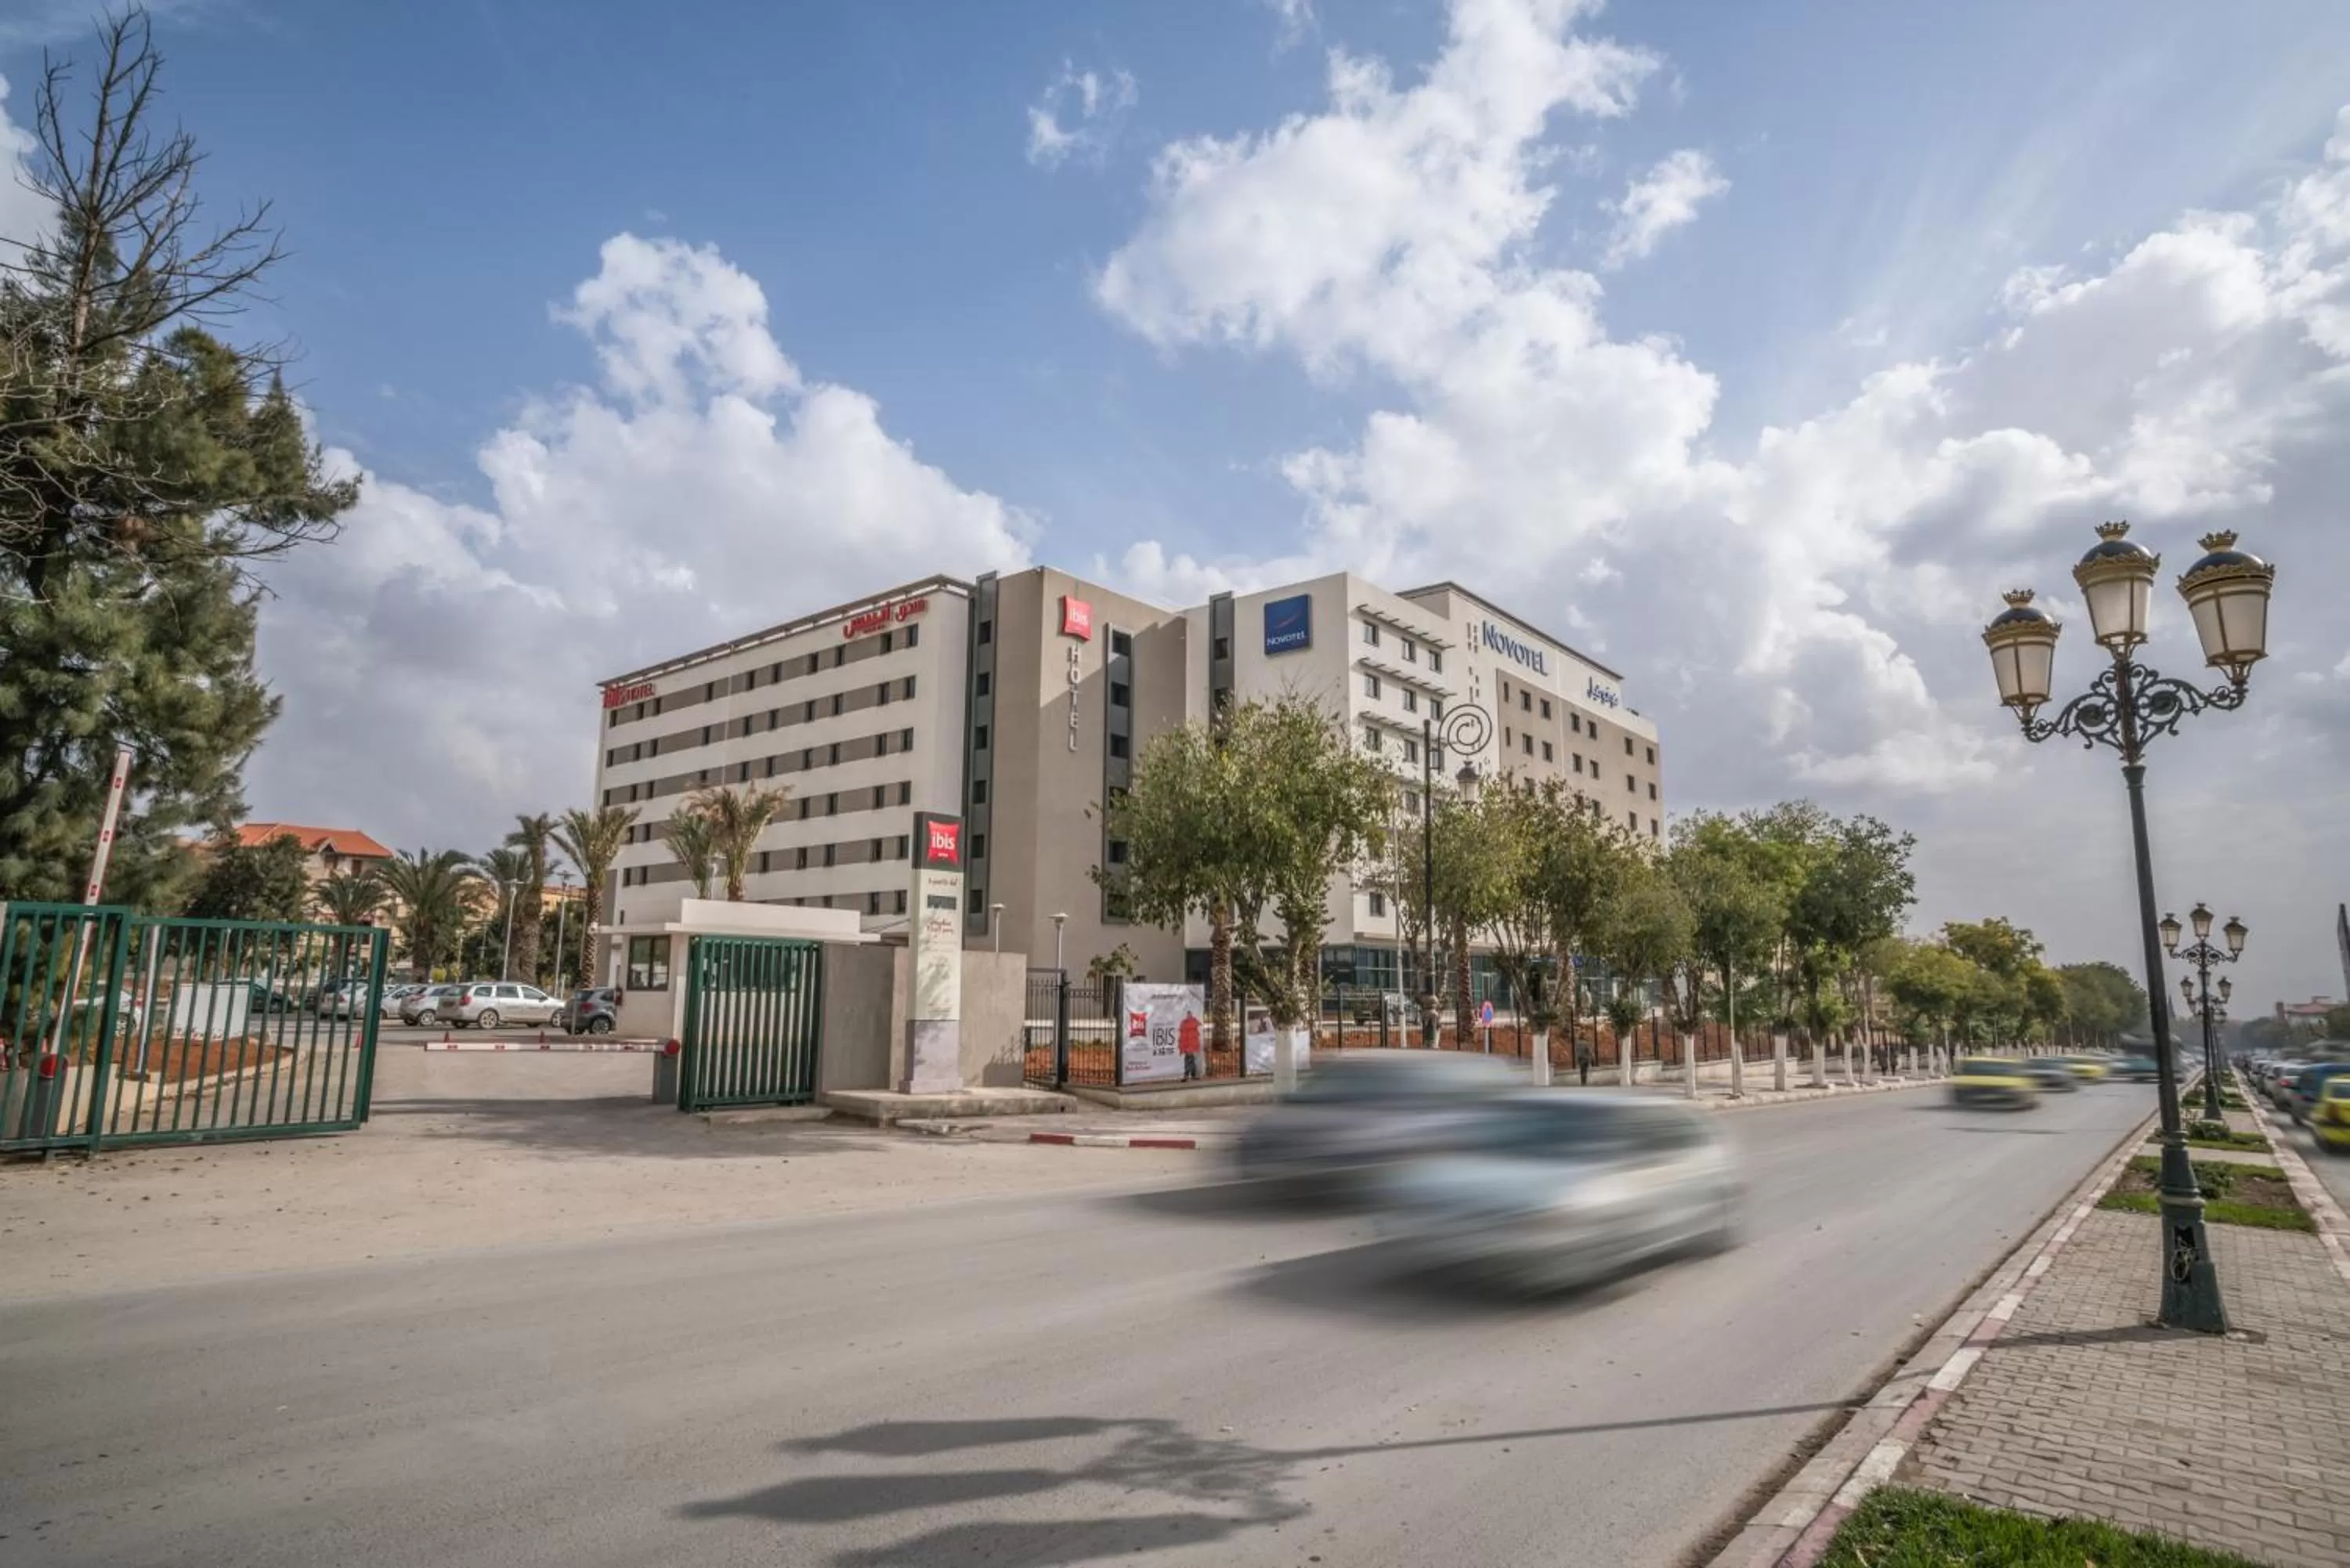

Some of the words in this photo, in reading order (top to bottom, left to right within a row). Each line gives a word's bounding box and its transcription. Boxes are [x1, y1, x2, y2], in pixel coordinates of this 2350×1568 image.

[1069, 607, 1088, 625] ibis
[1266, 630, 1307, 646] NOVOTEL
[1482, 620, 1548, 677] NOVOTEL
[1069, 645, 1080, 752] HOTEL
[931, 830, 956, 850] ibis
[1152, 1027, 1176, 1046] IBIS
